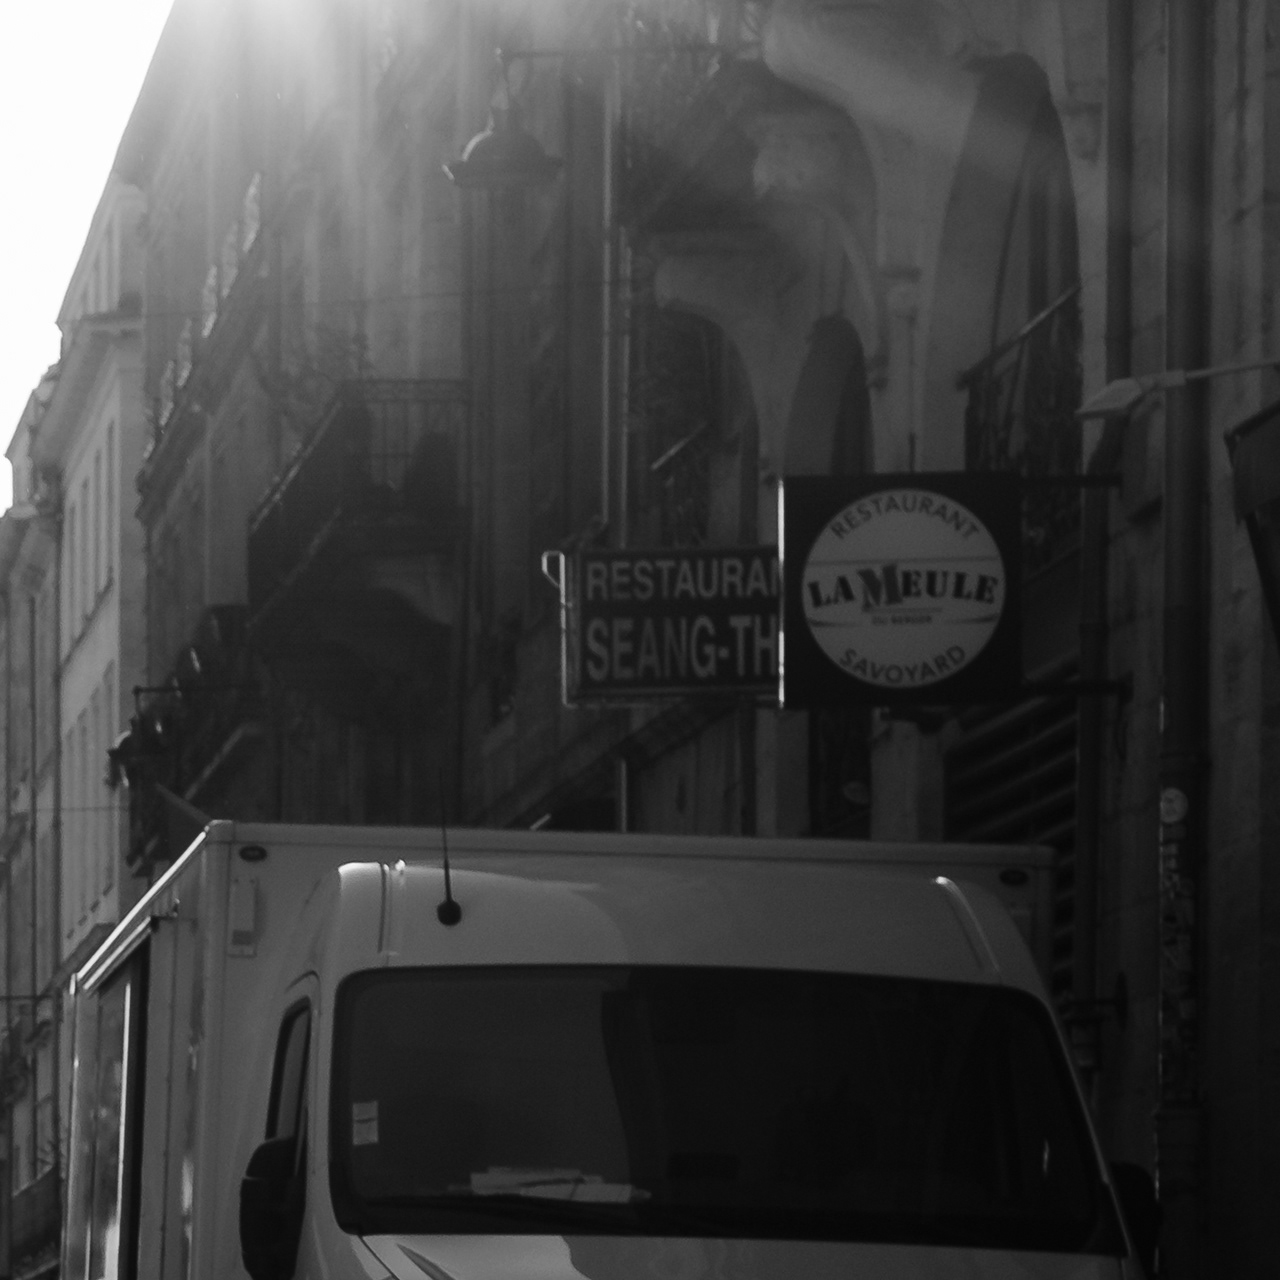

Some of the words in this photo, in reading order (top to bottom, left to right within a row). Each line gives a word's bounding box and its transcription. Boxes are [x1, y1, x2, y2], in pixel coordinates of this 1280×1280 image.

[830, 495, 981, 539] RESTAURANT
[808, 576, 855, 608] LA
[856, 564, 999, 612] MEULE
[586, 613, 777, 682] SEANG-TH
[840, 645, 967, 684] SAVOYARD
